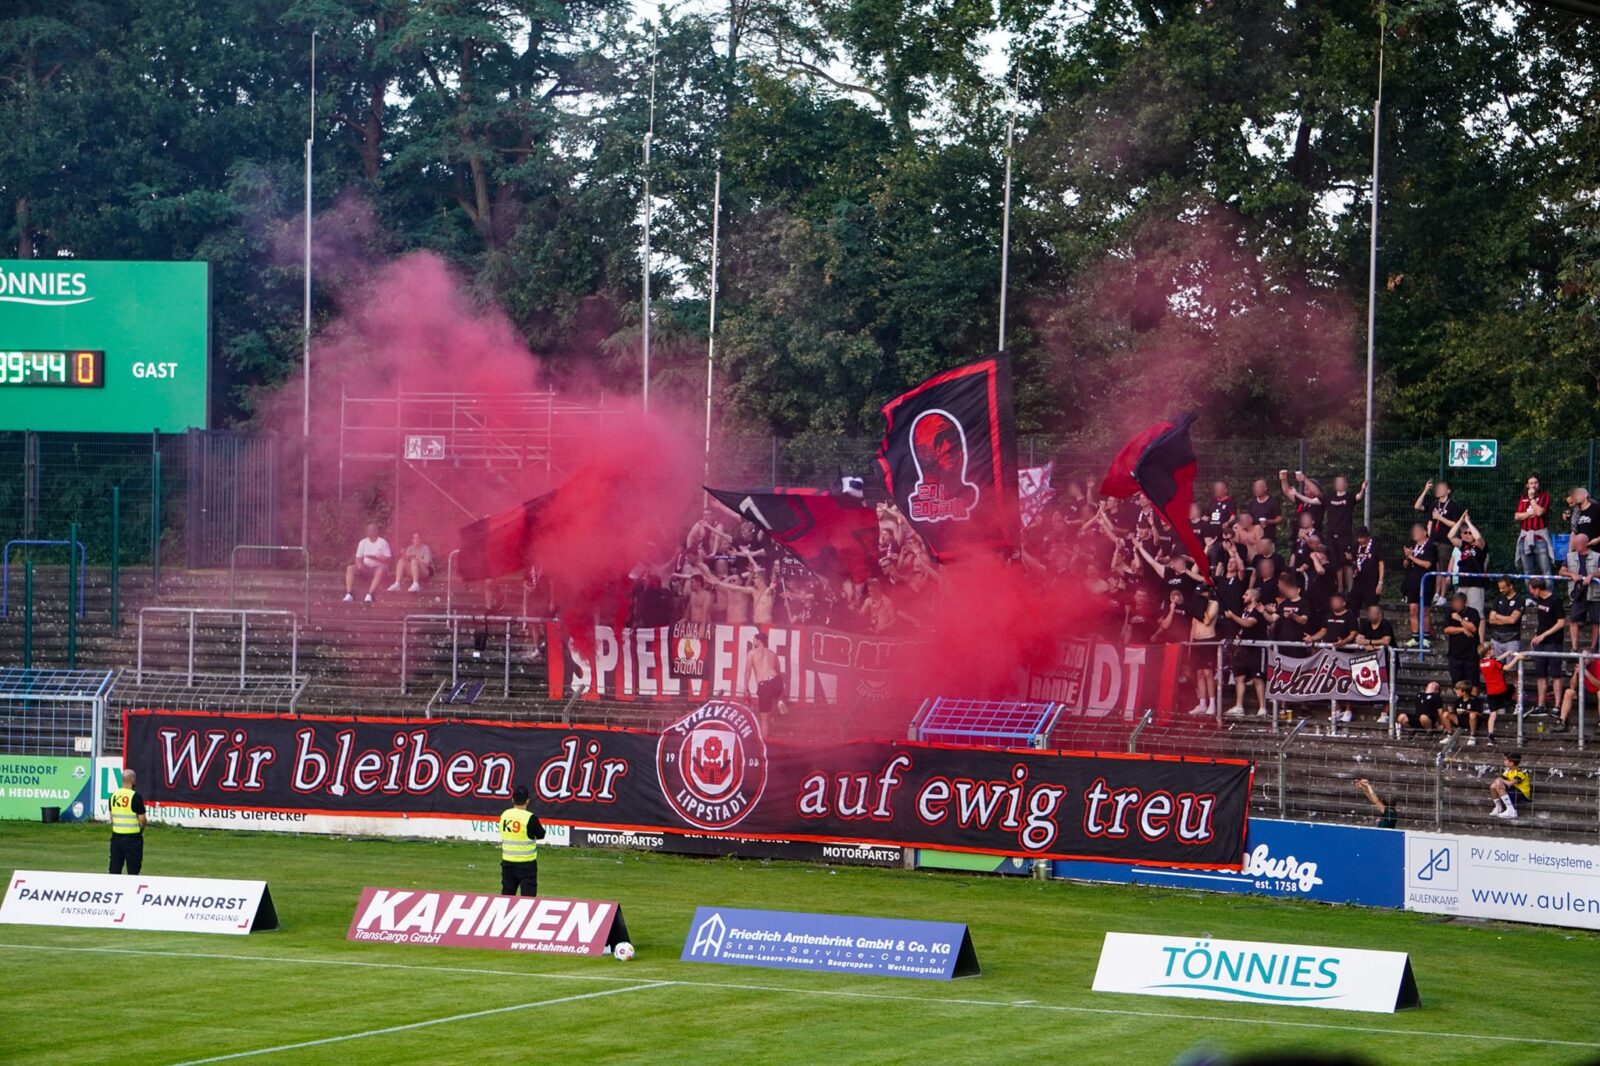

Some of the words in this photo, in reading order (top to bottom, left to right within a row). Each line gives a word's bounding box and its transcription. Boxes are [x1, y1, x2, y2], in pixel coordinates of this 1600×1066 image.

[78, 353, 94, 383] 0
[132, 362, 178, 379] GAST
[673, 623, 711, 640] BANAA
[673, 657, 704, 675] SQUAD
[675, 705, 753, 738] SPIELVEREIN
[666, 753, 675, 762] 19
[0, 764, 58, 774] HLENDORF
[9, 788, 70, 799] HEIDEWALD
[160, 730, 273, 789] Wir
[295, 730, 511, 796] bleiben
[538, 735, 626, 803] dir
[799, 754, 911, 817] auf
[919, 763, 1064, 850] ewig
[1085, 780, 1215, 841] treu
[112, 795, 129, 808] K9
[676, 789, 747, 821] LIPPSTADT
[200, 807, 236, 819] Klaus
[503, 820, 521, 833] K9
[1471, 847, 1485, 860] PV
[1494, 849, 1519, 863] Solar
[1529, 853, 1592, 869] Heizsysteme
[1255, 879, 1272, 889] est.
[1275, 880, 1297, 892] 1758
[18, 888, 123, 905] PANNHORST
[141, 893, 247, 911] PANNHORST
[1409, 893, 1458, 906] AULENKAMP
[61, 906, 115, 917] ENTSORGUNG
[184, 912, 239, 922] ENTSORGUNG
[356, 890, 612, 943] KAHMEN
[355, 929, 408, 943] TransCargo
[410, 932, 441, 943] GmbH
[729, 928, 781, 942] Friedrich
[783, 932, 853, 947] Amtenbrink
[856, 937, 894, 950] GmbH
[895, 940, 905, 951] &
[908, 941, 928, 953] Co.
[931, 943, 950, 954] KG
[511, 941, 589, 954] www.kahmen.de
[827, 958, 873, 969] Baugruppen
[887, 963, 945, 974] Werkzeugstahl
[1162, 941, 1341, 989] TÖNNIES
